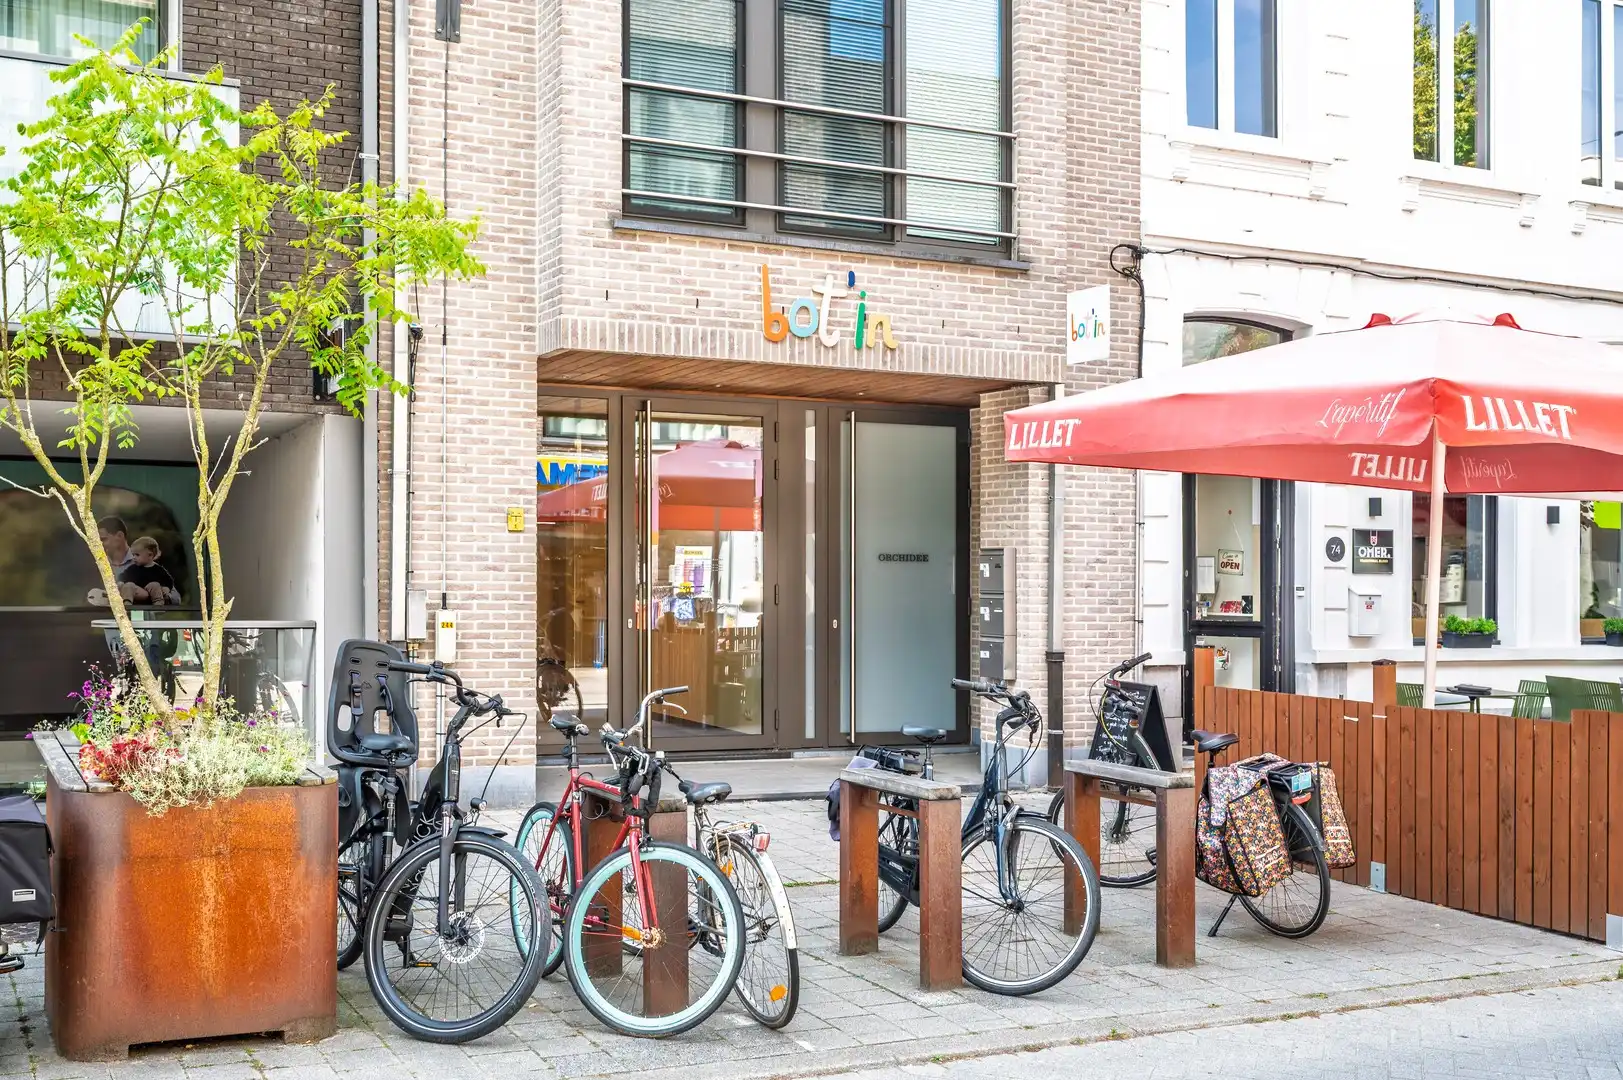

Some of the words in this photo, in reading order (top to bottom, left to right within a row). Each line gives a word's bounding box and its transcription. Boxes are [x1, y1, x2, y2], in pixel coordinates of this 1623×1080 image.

[761, 263, 899, 349] bot'in
[1071, 307, 1106, 342] bot'in
[1461, 394, 1573, 441] LILLET
[1008, 418, 1080, 451] LILLET
[878, 553, 929, 562] ORCHIDEE
[1220, 561, 1240, 570] OPEN
[1330, 544, 1341, 556] 74
